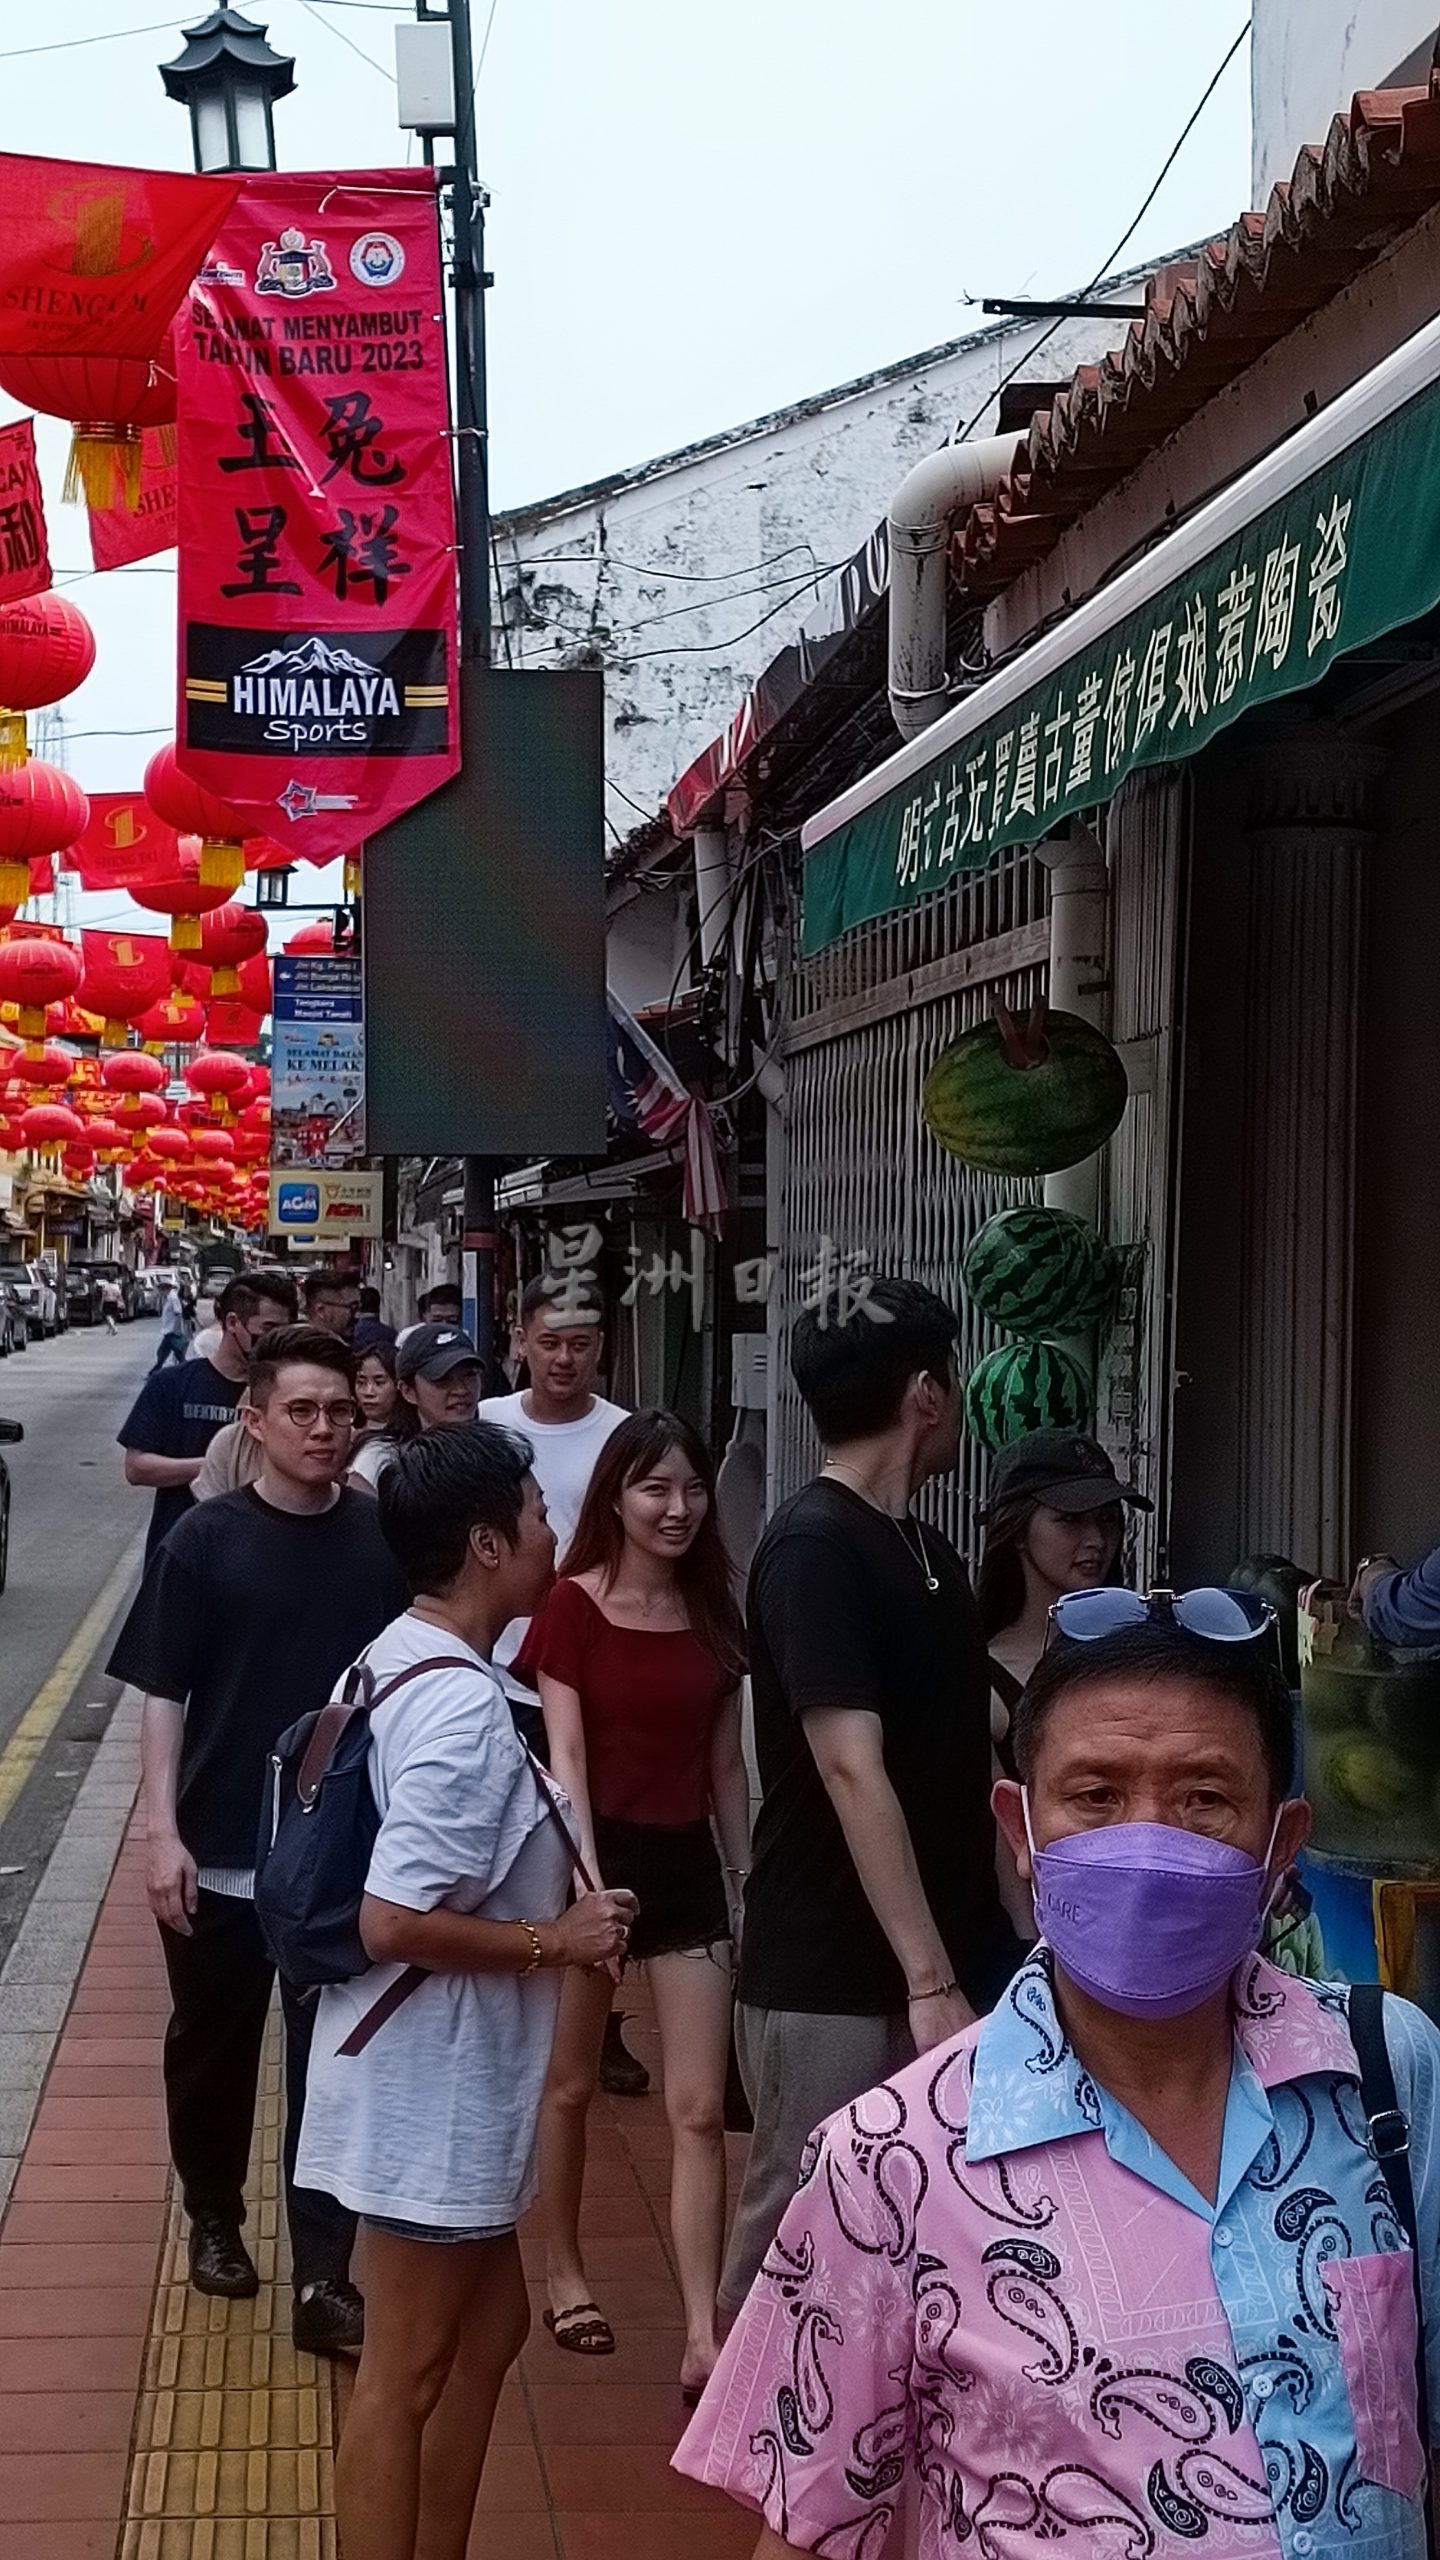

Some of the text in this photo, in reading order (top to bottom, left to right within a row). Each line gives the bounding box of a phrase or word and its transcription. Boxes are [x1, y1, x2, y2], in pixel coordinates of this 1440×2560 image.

[192, 299, 424, 341] SEAMAT MENYAMBUT
[279, 344, 352, 376] BARU
[362, 341, 424, 373] 2023
[218, 504, 411, 607] 呈祥
[233, 675, 400, 717] HIMALAYA
[263, 718, 368, 752] Sports
[287, 1059, 307, 1071] KE
[282, 1196, 317, 1210] AGM
